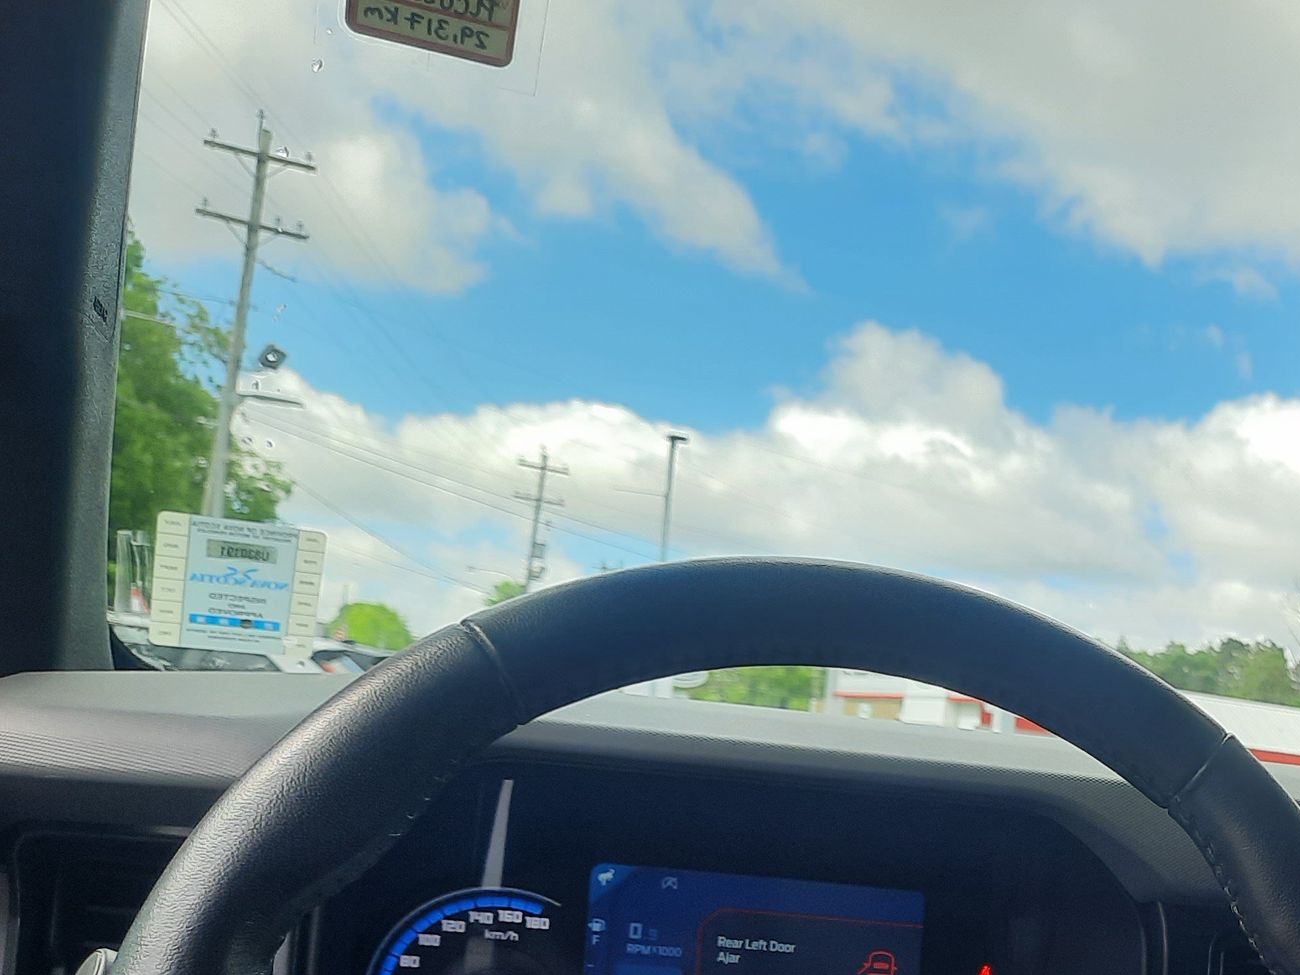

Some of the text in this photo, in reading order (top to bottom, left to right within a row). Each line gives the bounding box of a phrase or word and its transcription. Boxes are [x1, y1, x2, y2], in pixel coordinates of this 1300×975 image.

[468, 911, 494, 925] 140
[484, 928, 520, 942] km/h
[717, 936, 796, 953] Rear Left Door
[716, 951, 741, 965] Ajar
